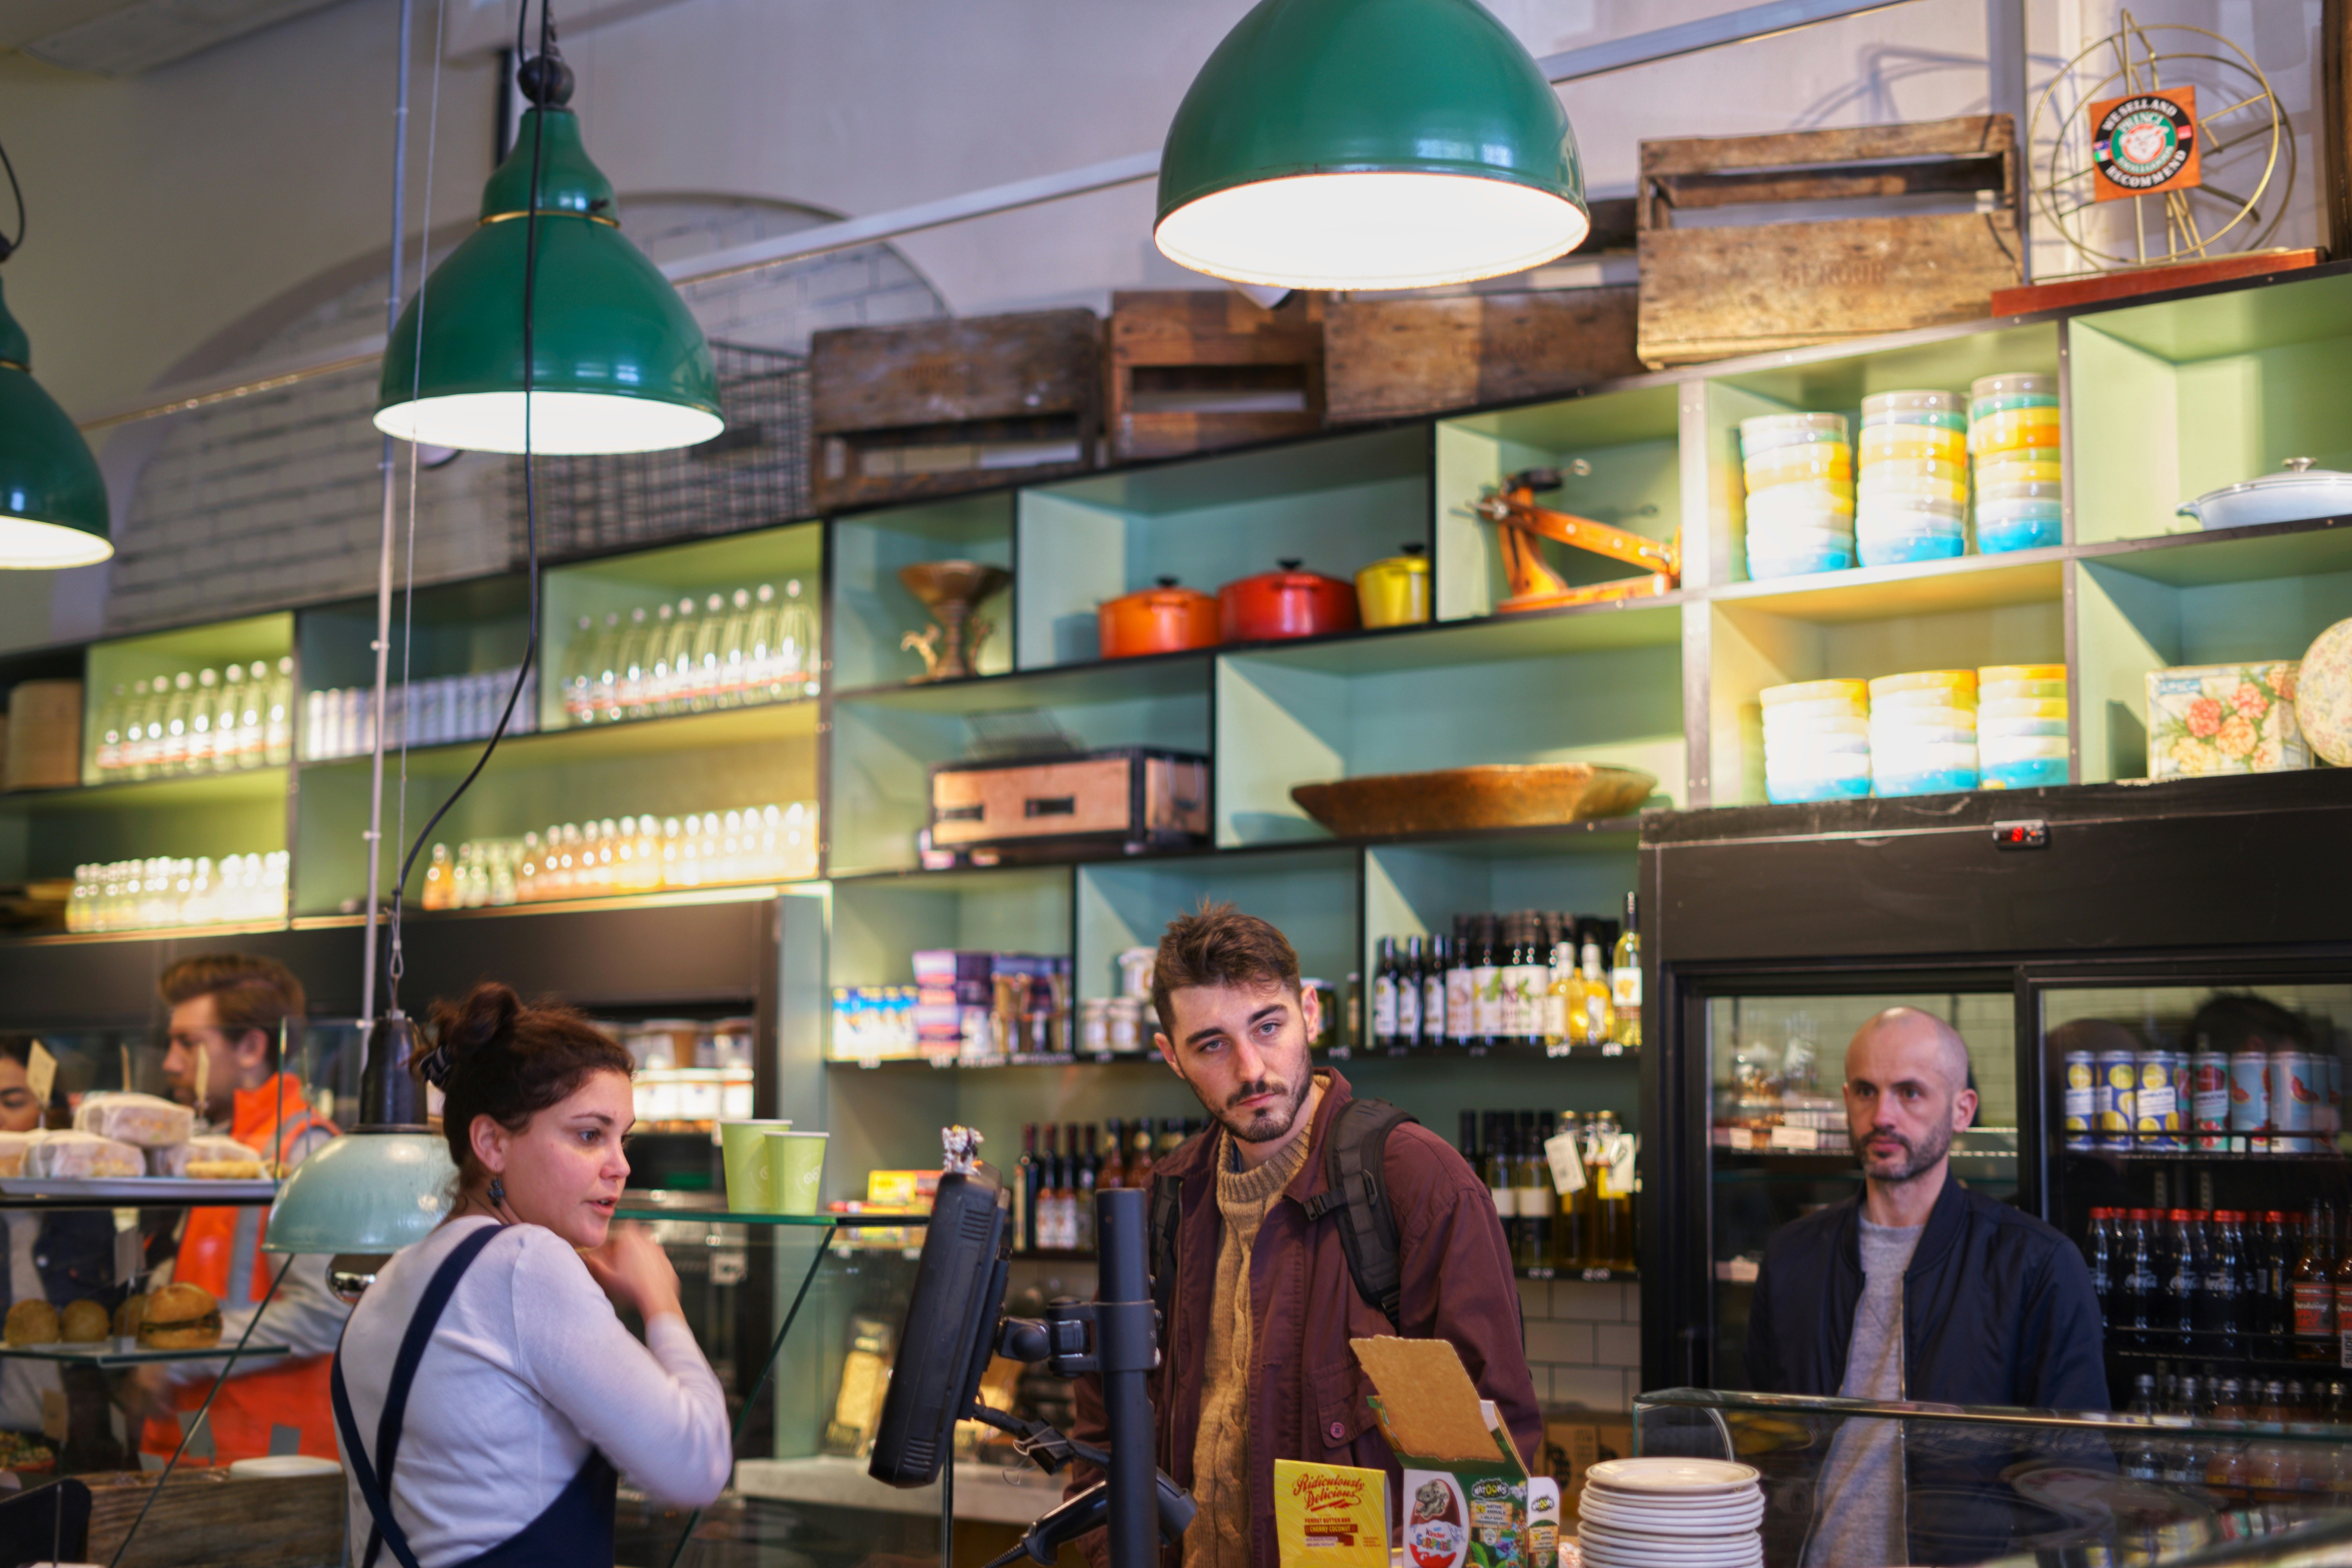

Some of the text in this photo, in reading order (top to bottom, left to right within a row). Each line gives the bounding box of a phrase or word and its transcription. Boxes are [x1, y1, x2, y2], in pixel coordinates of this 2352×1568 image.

[2102, 98, 2178, 131] WE SELL AND
[2105, 150, 2187, 187] RECOMMEND
[1292, 1473, 1365, 1496] Ridiculously
[1305, 1487, 1357, 1509] Delicious
[1310, 1525, 1328, 1534] CHERRY
[1416, 1533, 1452, 1552] SURPRISE
